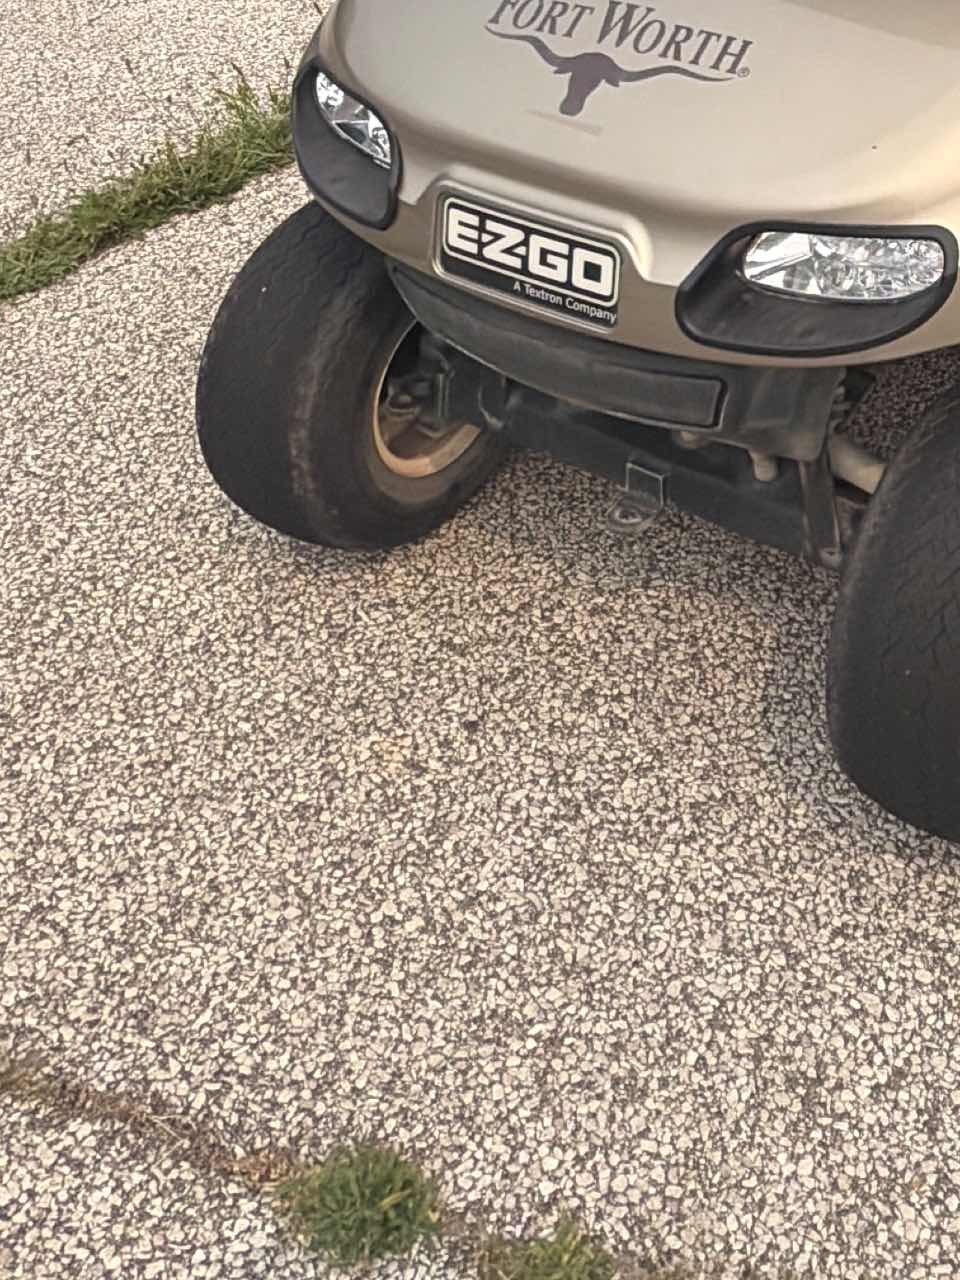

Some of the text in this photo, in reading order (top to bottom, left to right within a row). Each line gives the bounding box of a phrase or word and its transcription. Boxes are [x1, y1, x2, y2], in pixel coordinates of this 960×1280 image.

[596, 0, 753, 75] WORTH
[447, 206, 613, 297] EZGO
[513, 280, 617, 325] A Textron Company
